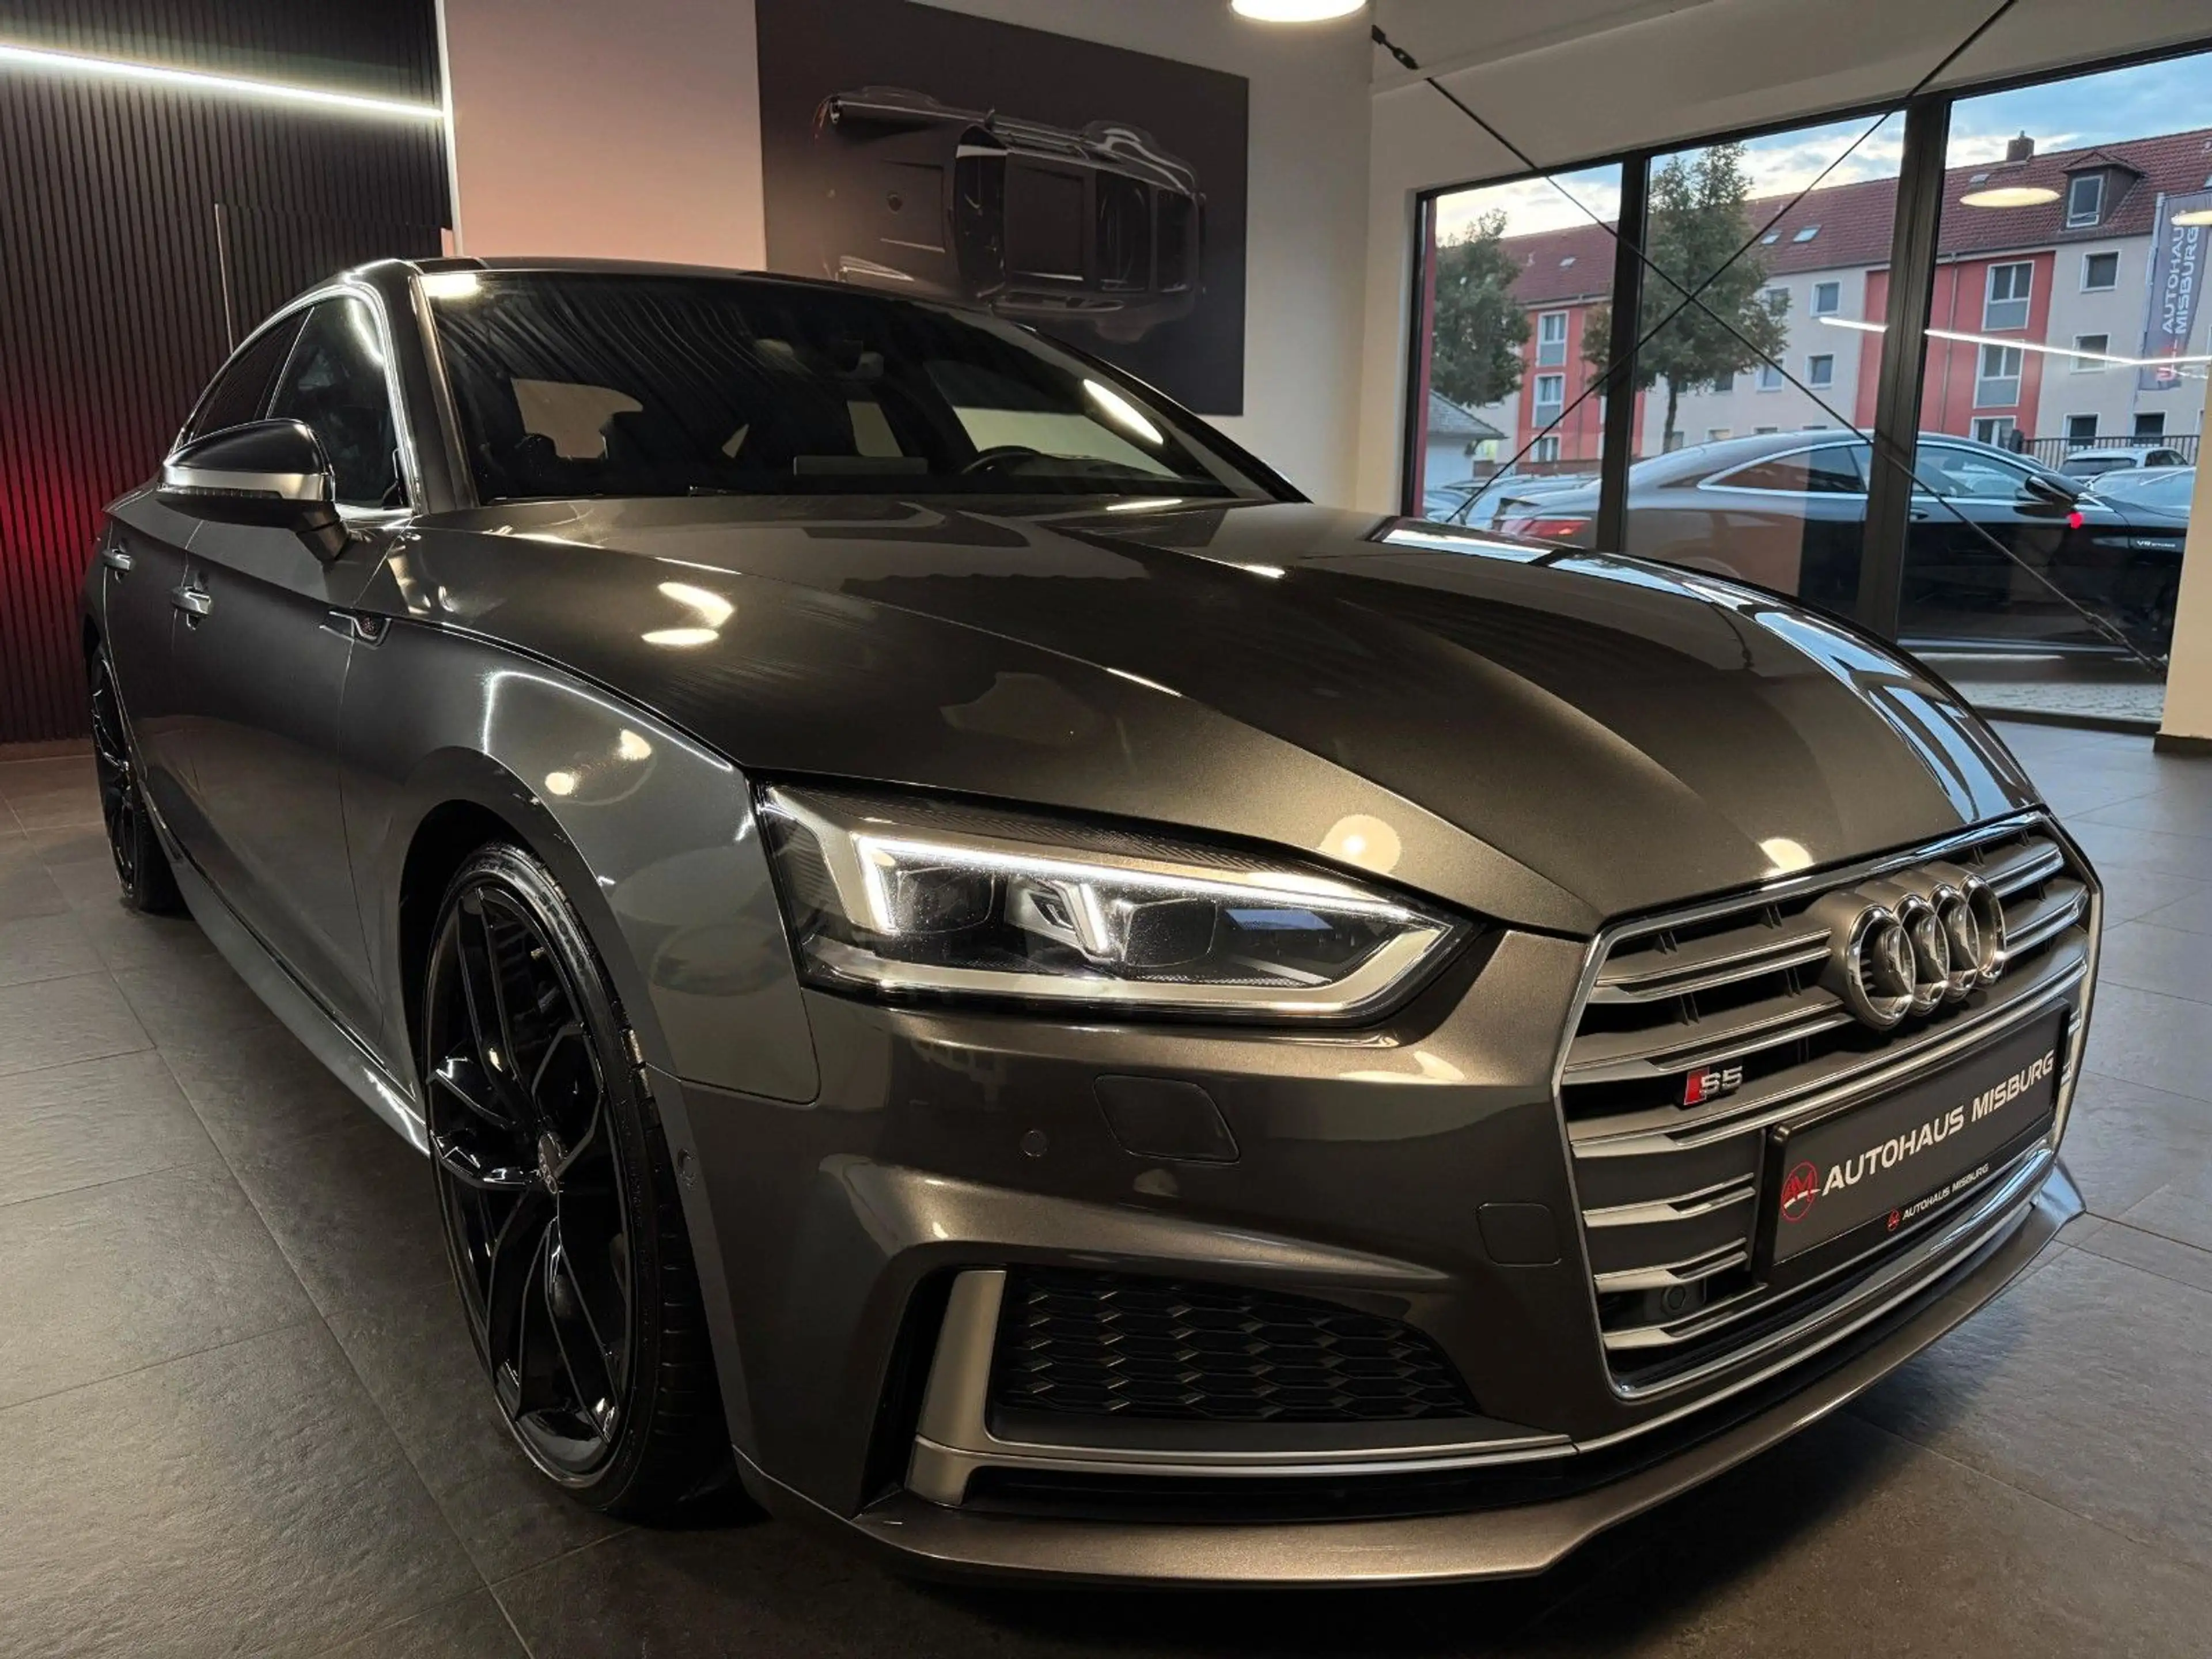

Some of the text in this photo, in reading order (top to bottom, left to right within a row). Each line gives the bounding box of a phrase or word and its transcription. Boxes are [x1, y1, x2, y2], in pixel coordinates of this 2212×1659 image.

[2162, 213, 2184, 335] AUTOHAU
[2175, 225, 2200, 335] MISBURG
[1699, 1066, 1743, 1096] S5
[1823, 1105, 1965, 1197] AUTOHAUS
[1971, 1049, 2055, 1123] MISBURG
[1902, 1186, 1950, 1220] AUTOHAUS
[1952, 1162, 1989, 1192] MISBURG
